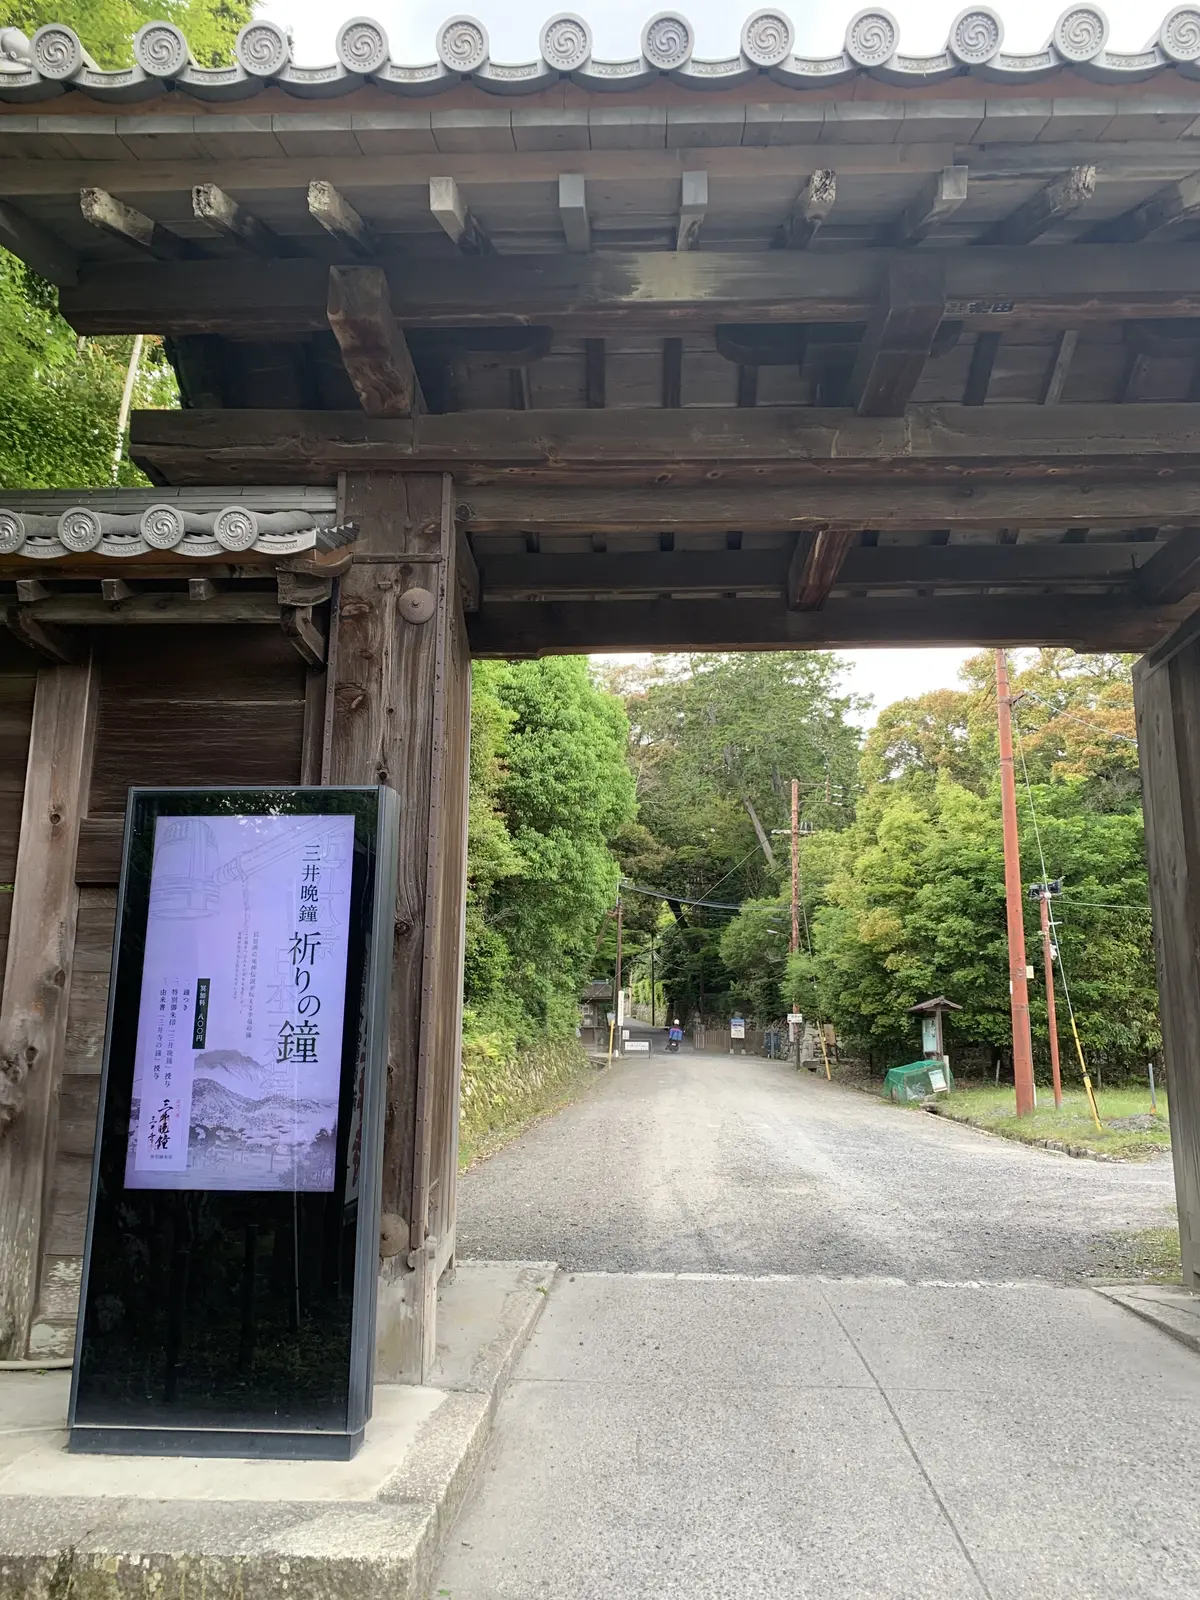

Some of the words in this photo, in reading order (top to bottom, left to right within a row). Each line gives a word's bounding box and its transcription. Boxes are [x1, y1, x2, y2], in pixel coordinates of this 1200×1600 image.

[299, 844, 320, 922] 三井晩鐘
[276, 931, 321, 1064] 祈りの鐘
